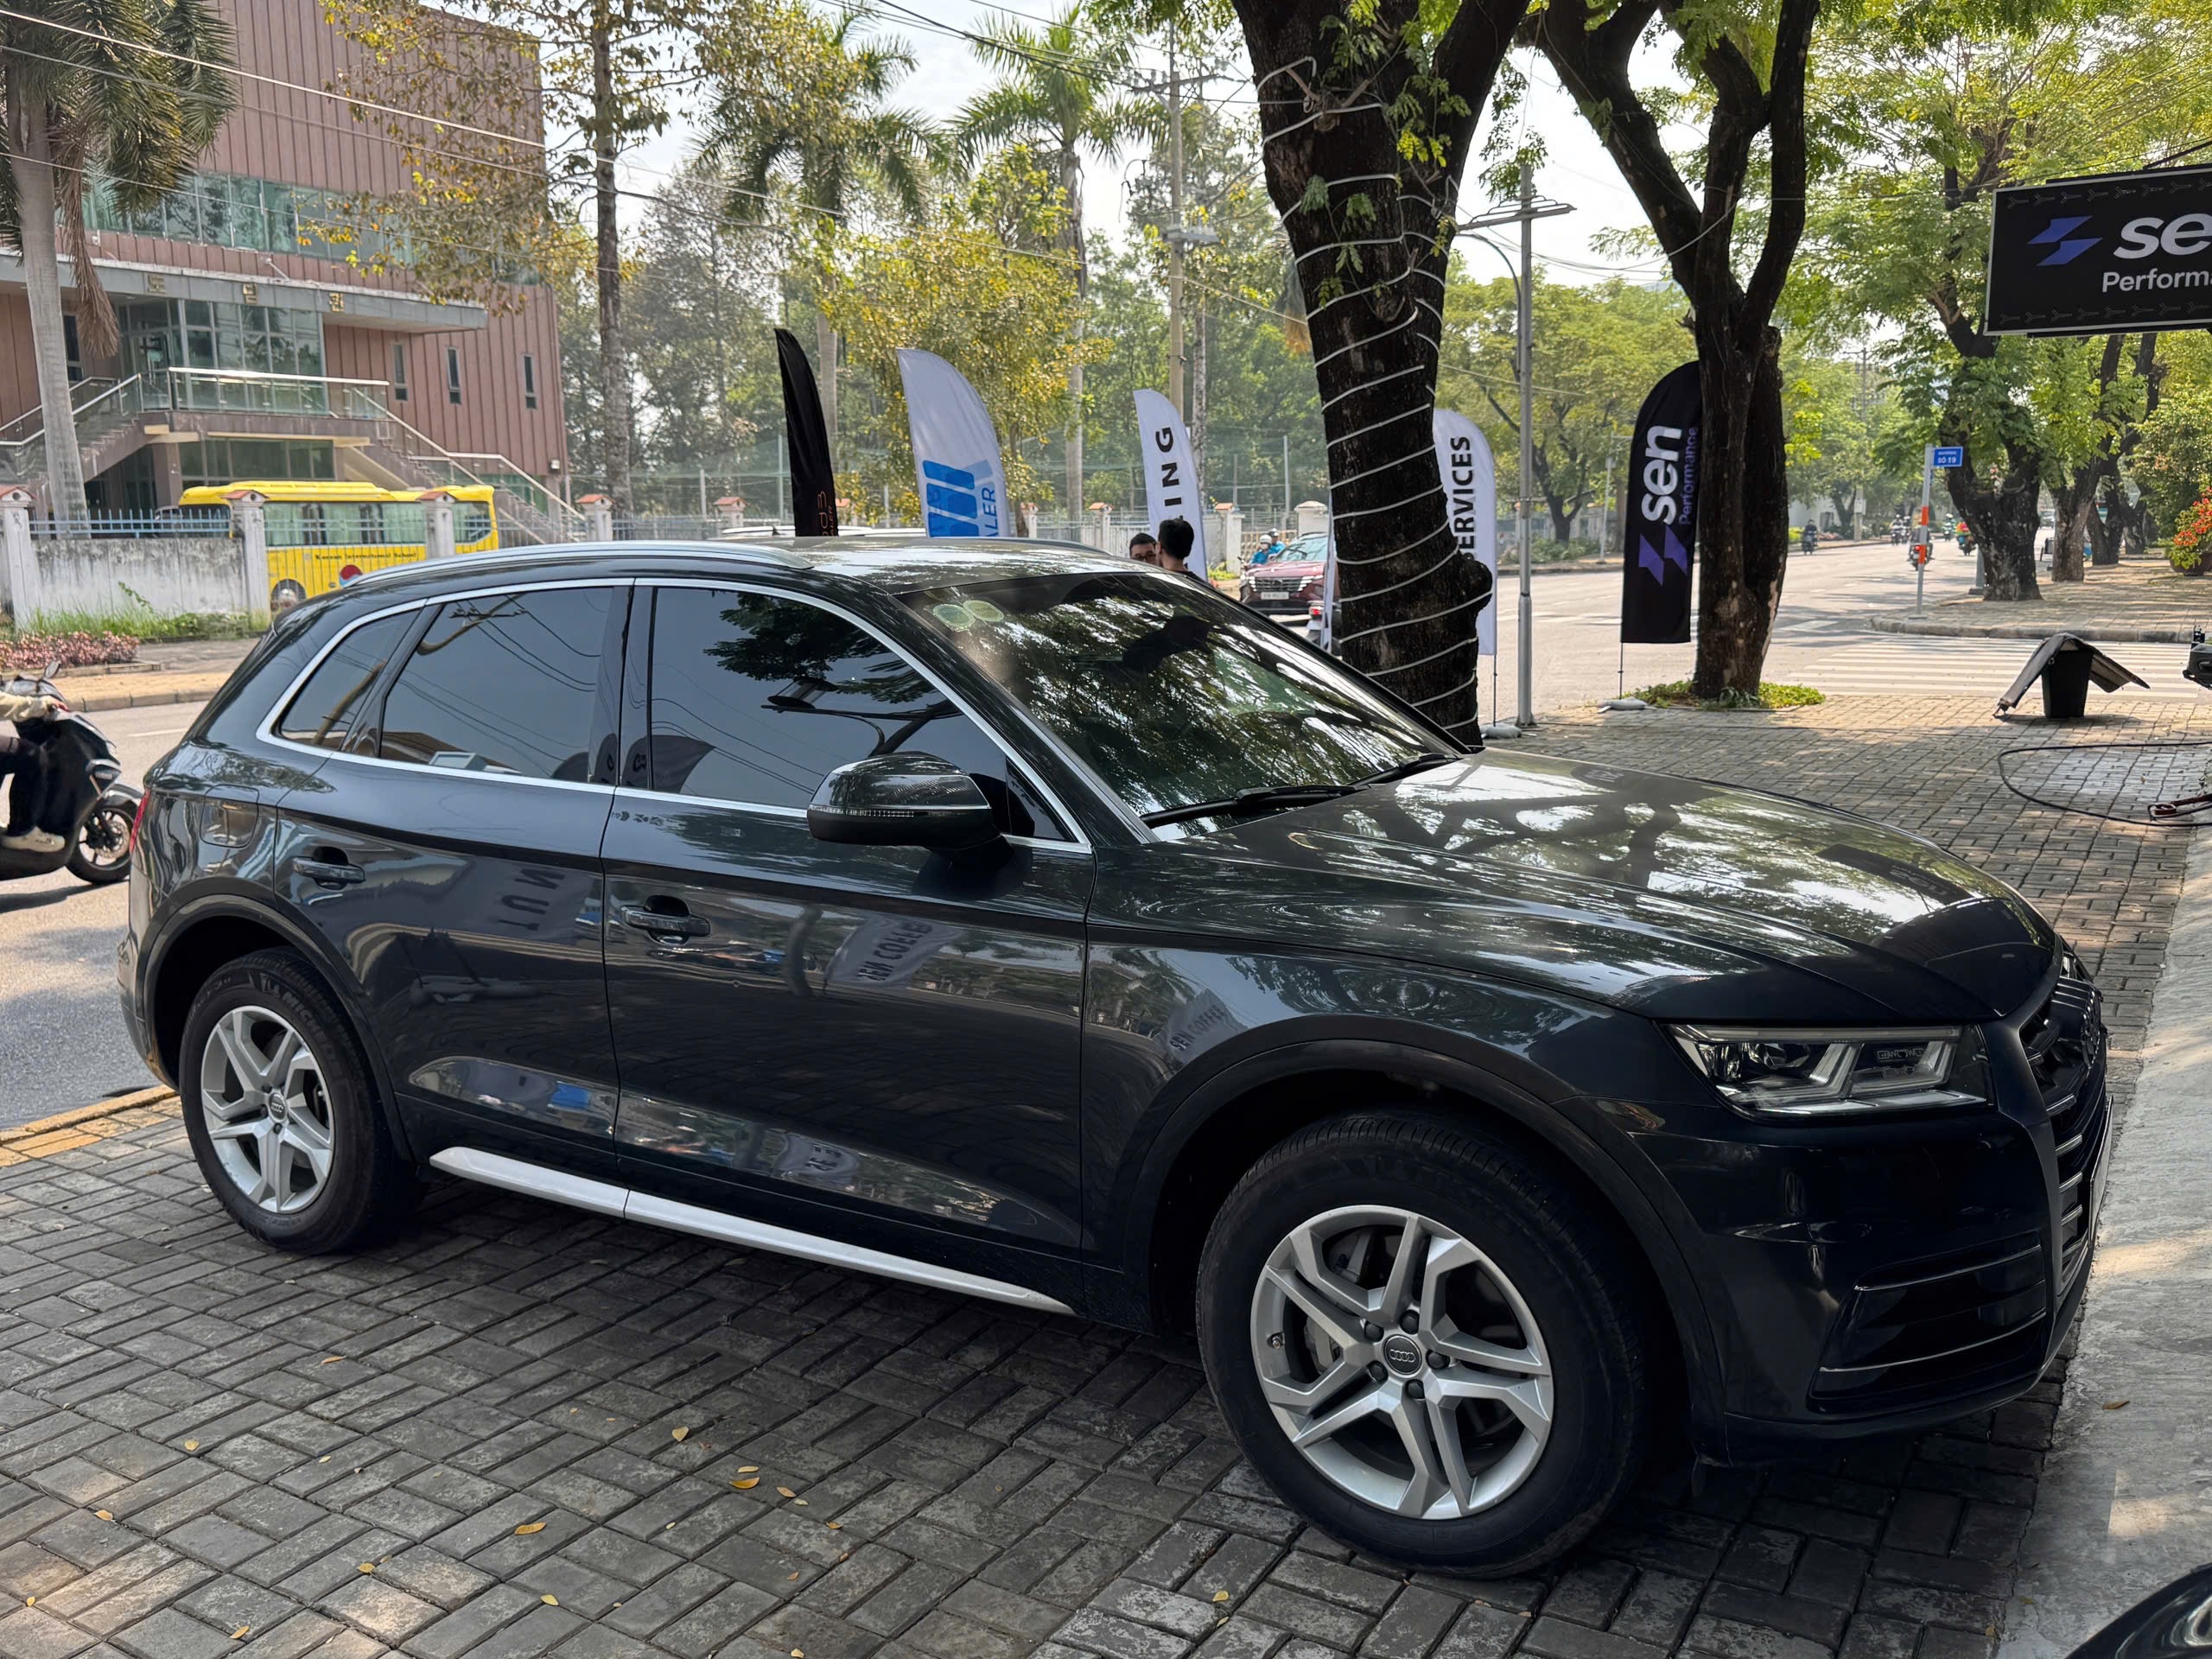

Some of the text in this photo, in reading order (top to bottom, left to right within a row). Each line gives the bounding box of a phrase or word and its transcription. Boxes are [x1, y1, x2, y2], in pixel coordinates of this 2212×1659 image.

[2101, 268, 2212, 293] Perform
[1155, 427, 1184, 520] ING
[1642, 425, 1682, 525] sen
[1679, 427, 1699, 526] Performance
